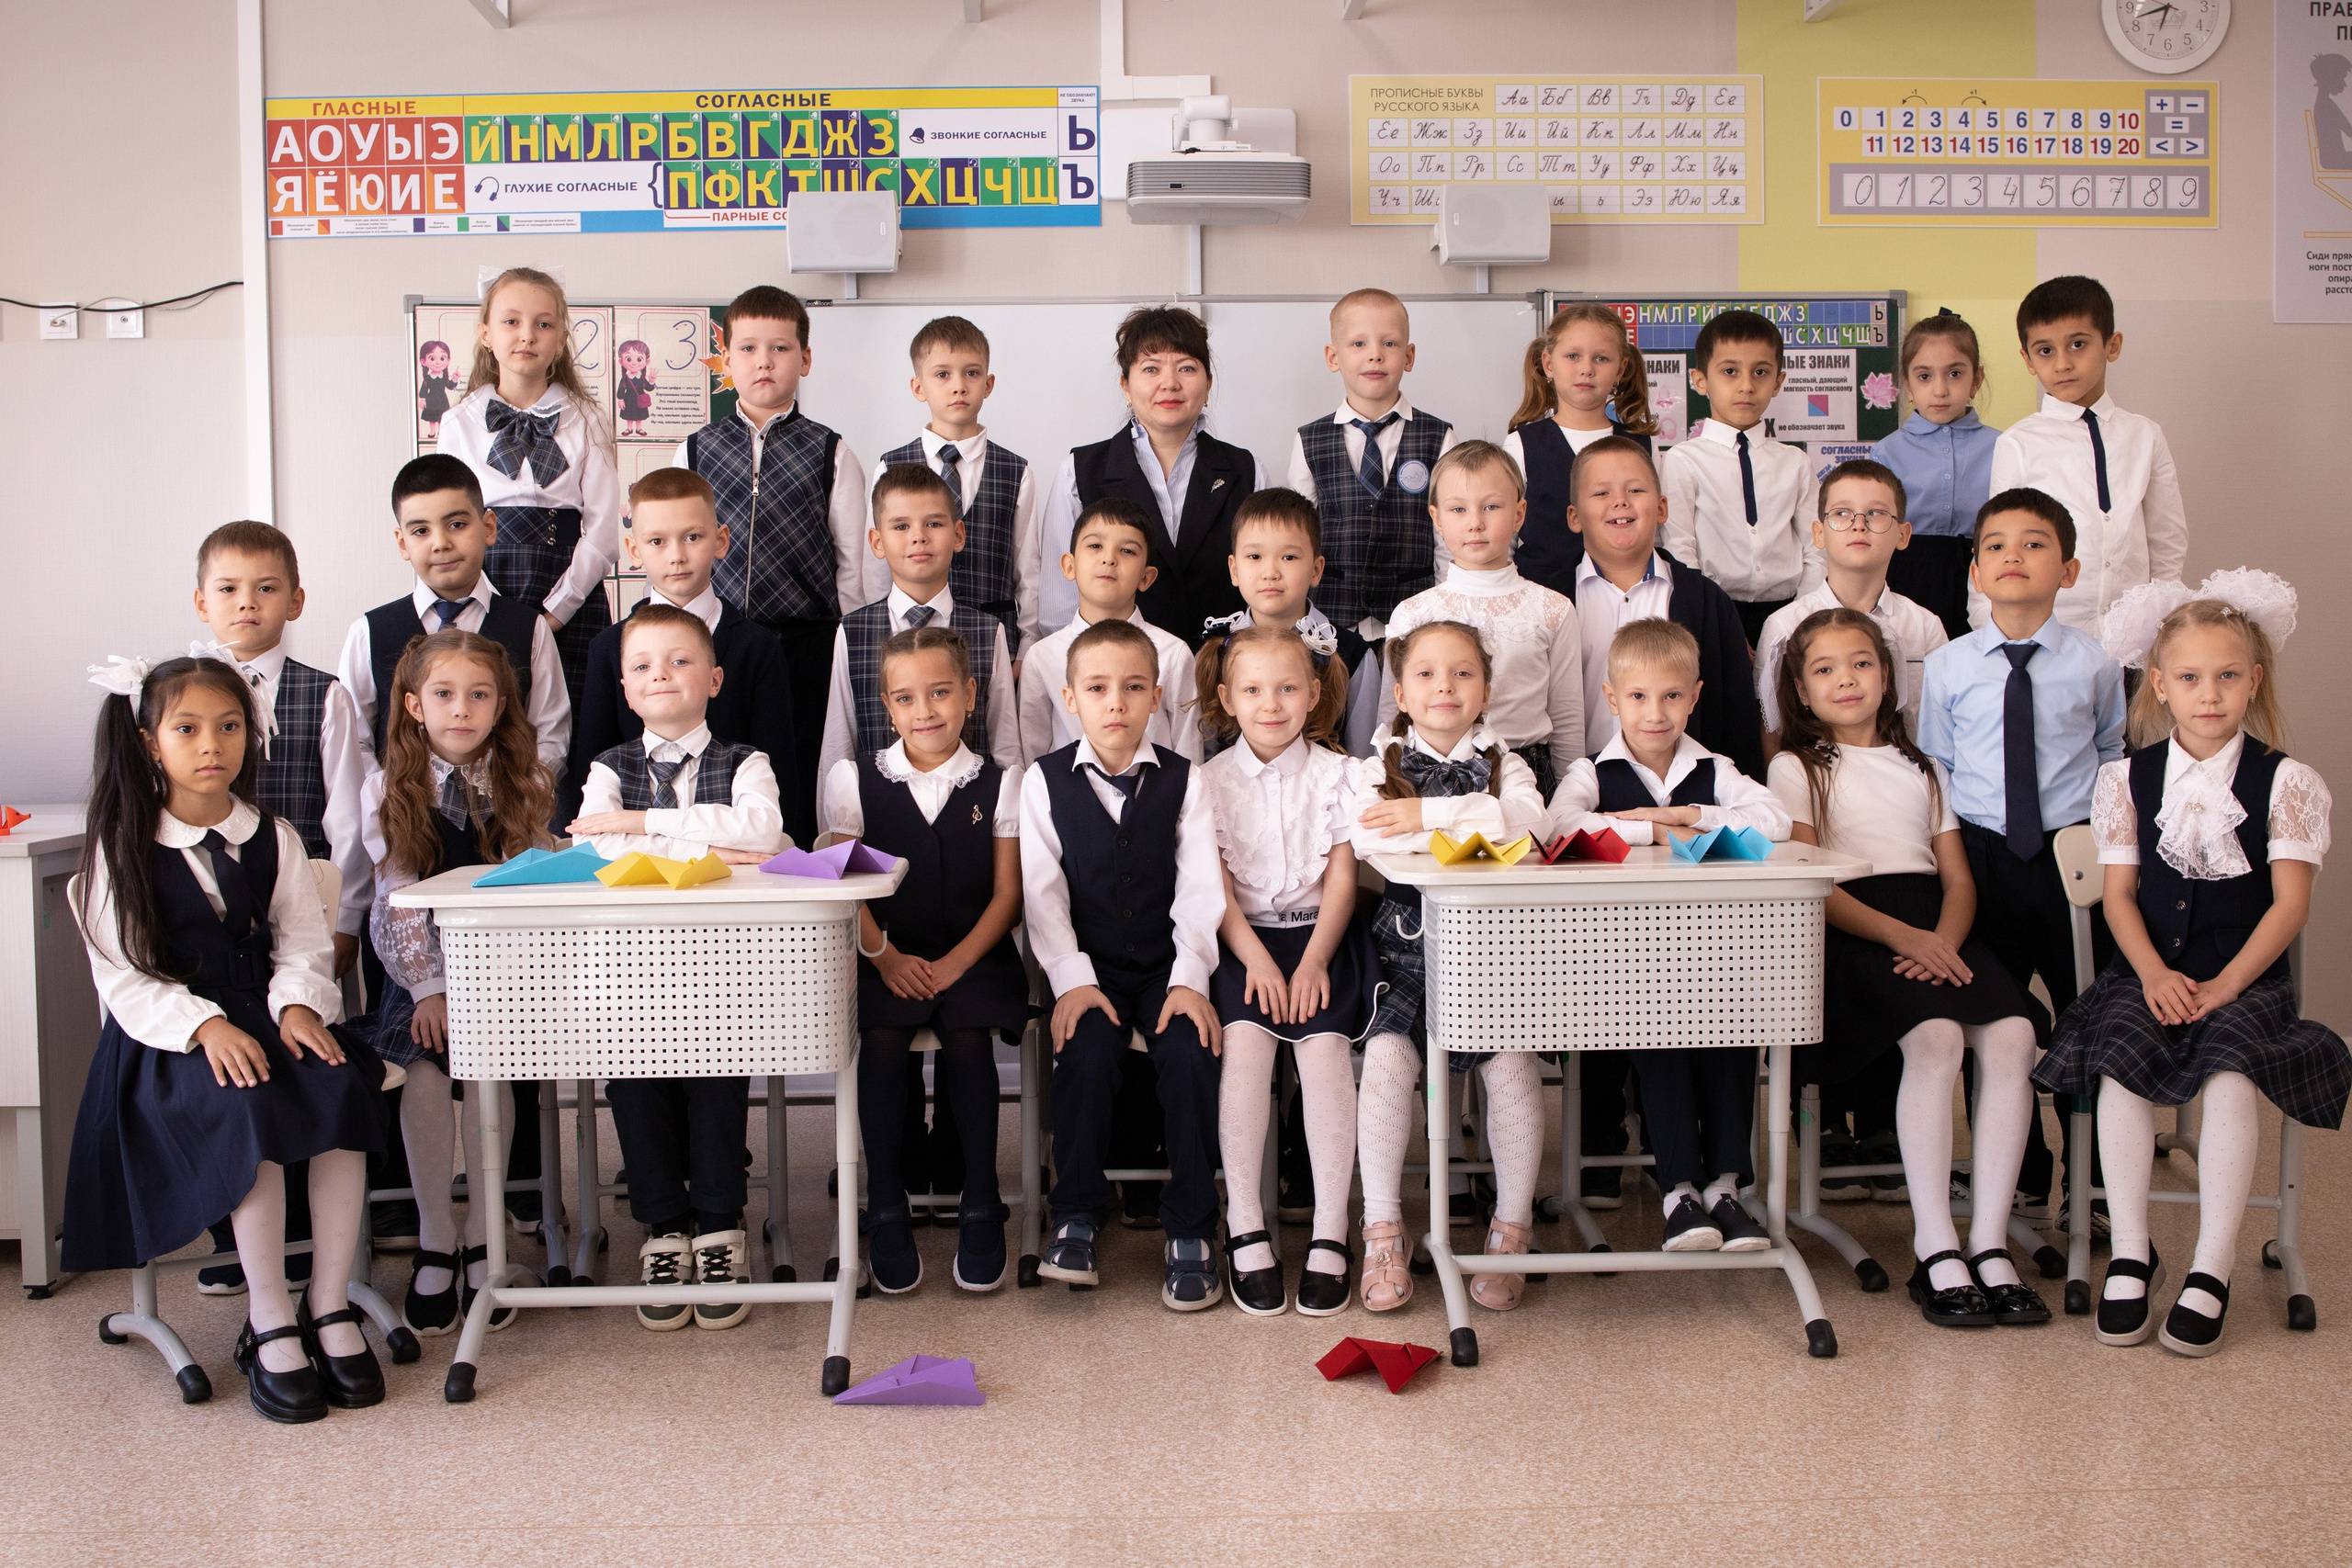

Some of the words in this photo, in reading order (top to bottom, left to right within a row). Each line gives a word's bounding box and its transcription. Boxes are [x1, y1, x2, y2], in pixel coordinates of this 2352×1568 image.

[2126, 2, 2133, 13] 9
[2200, 0, 2209, 13] 3
[2132, 20, 2141, 31] 8
[2196, 19, 2202, 30] 4
[2148, 34, 2154, 45] 7
[2165, 39, 2172, 51] 6
[2184, 33, 2191, 45] 5
[1370, 88, 1443, 98] ПРОПИСНЫЕ
[1447, 88, 1483, 97] БУКВЫ
[695, 93, 831, 108] СОГЛАСНЫЕ
[1374, 102, 1439, 111] РУССКОГО
[1442, 101, 1480, 111] ЯЗЫКА
[312, 101, 416, 116] ГЛАСНЫЕ
[1840, 110, 1852, 127] 0
[1876, 111, 1883, 127] 1
[1903, 111, 1914, 127] 2
[1930, 111, 1941, 128] 3
[1959, 111, 1970, 128] 4
[1987, 111, 1998, 129] 5
[2016, 111, 2028, 129] 6
[2043, 112, 2055, 129] 7
[2072, 112, 2082, 129] 8
[2100, 112, 2111, 129] 9
[2119, 113, 2139, 130] 10
[930, 130, 981, 140] ЗВОНКИЕ
[984, 130, 1047, 140] СОГЛАСНЫЕ
[1867, 136, 1883, 152] 11
[1893, 136, 1915, 153] 12
[1921, 137, 1942, 153] 13
[1950, 137, 1971, 153] 14
[1977, 137, 1999, 153] 15
[2007, 137, 2028, 153] 16
[2034, 138, 2055, 153] 17
[2062, 138, 2083, 154] 18
[2090, 138, 2111, 154] 19
[2118, 139, 2139, 154] 20
[504, 183, 553, 193] ГЛУХИЕ
[557, 181, 638, 193] СОГЛАСНЫЕ
[1855, 175, 1873, 205] 0
[1898, 175, 1909, 205] 1
[1928, 175, 1946, 205] 2
[1964, 175, 1982, 206] 3
[2003, 176, 2018, 206] 4
[2036, 176, 2054, 206] 5
[2072, 177, 2090, 207] 6
[2109, 177, 2125, 207] 7
[2143, 177, 2161, 207] 8
[2179, 177, 2197, 207] 9
[712, 212, 769, 221] ПАРНЫЕ
[2307, 251, 2329, 261] Сиди
[2328, 276, 2352, 284] опир
[571, 319, 600, 370] 2
[665, 320, 696, 371] 3
[1809, 355, 1849, 368] ЗНАКИ
